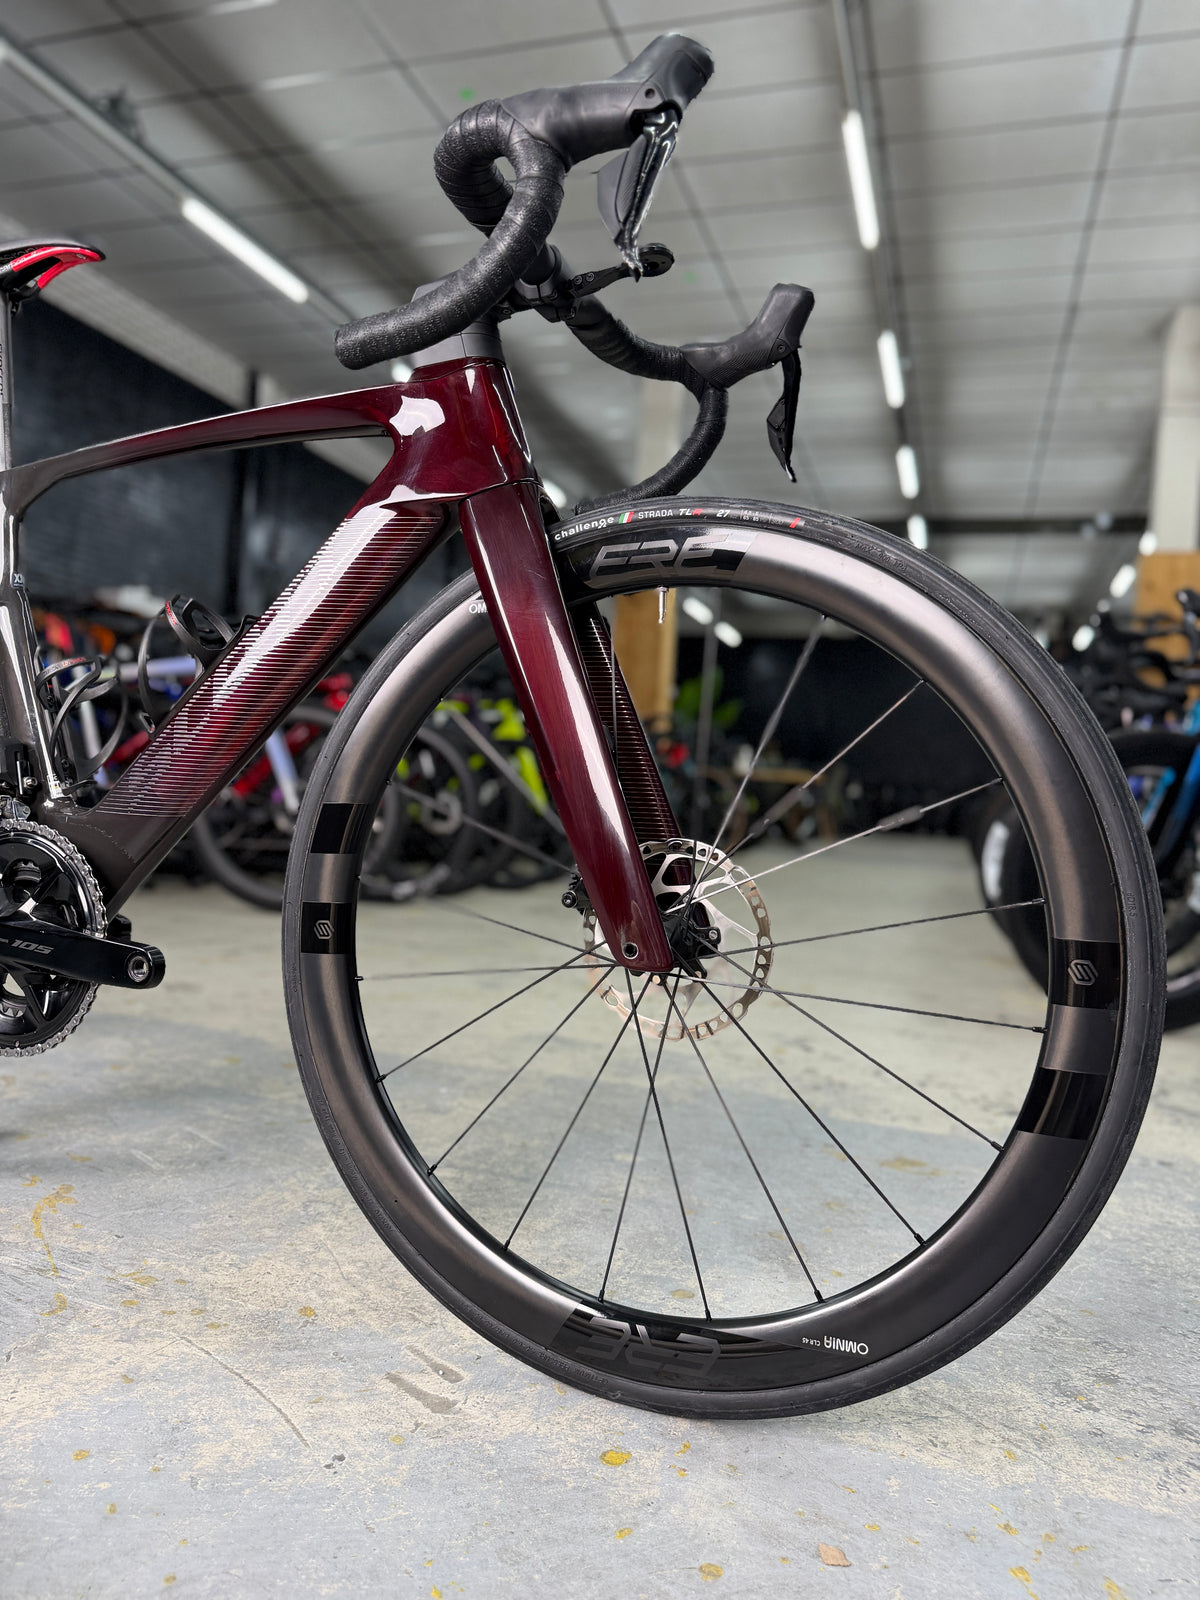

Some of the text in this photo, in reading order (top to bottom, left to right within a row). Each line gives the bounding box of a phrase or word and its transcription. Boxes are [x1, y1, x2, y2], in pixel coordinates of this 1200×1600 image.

[554, 507, 731, 541] challenge STRADA TLR 27
[11, 939, 54, 955] 105
[823, 1335, 869, 1355] OMNIA
